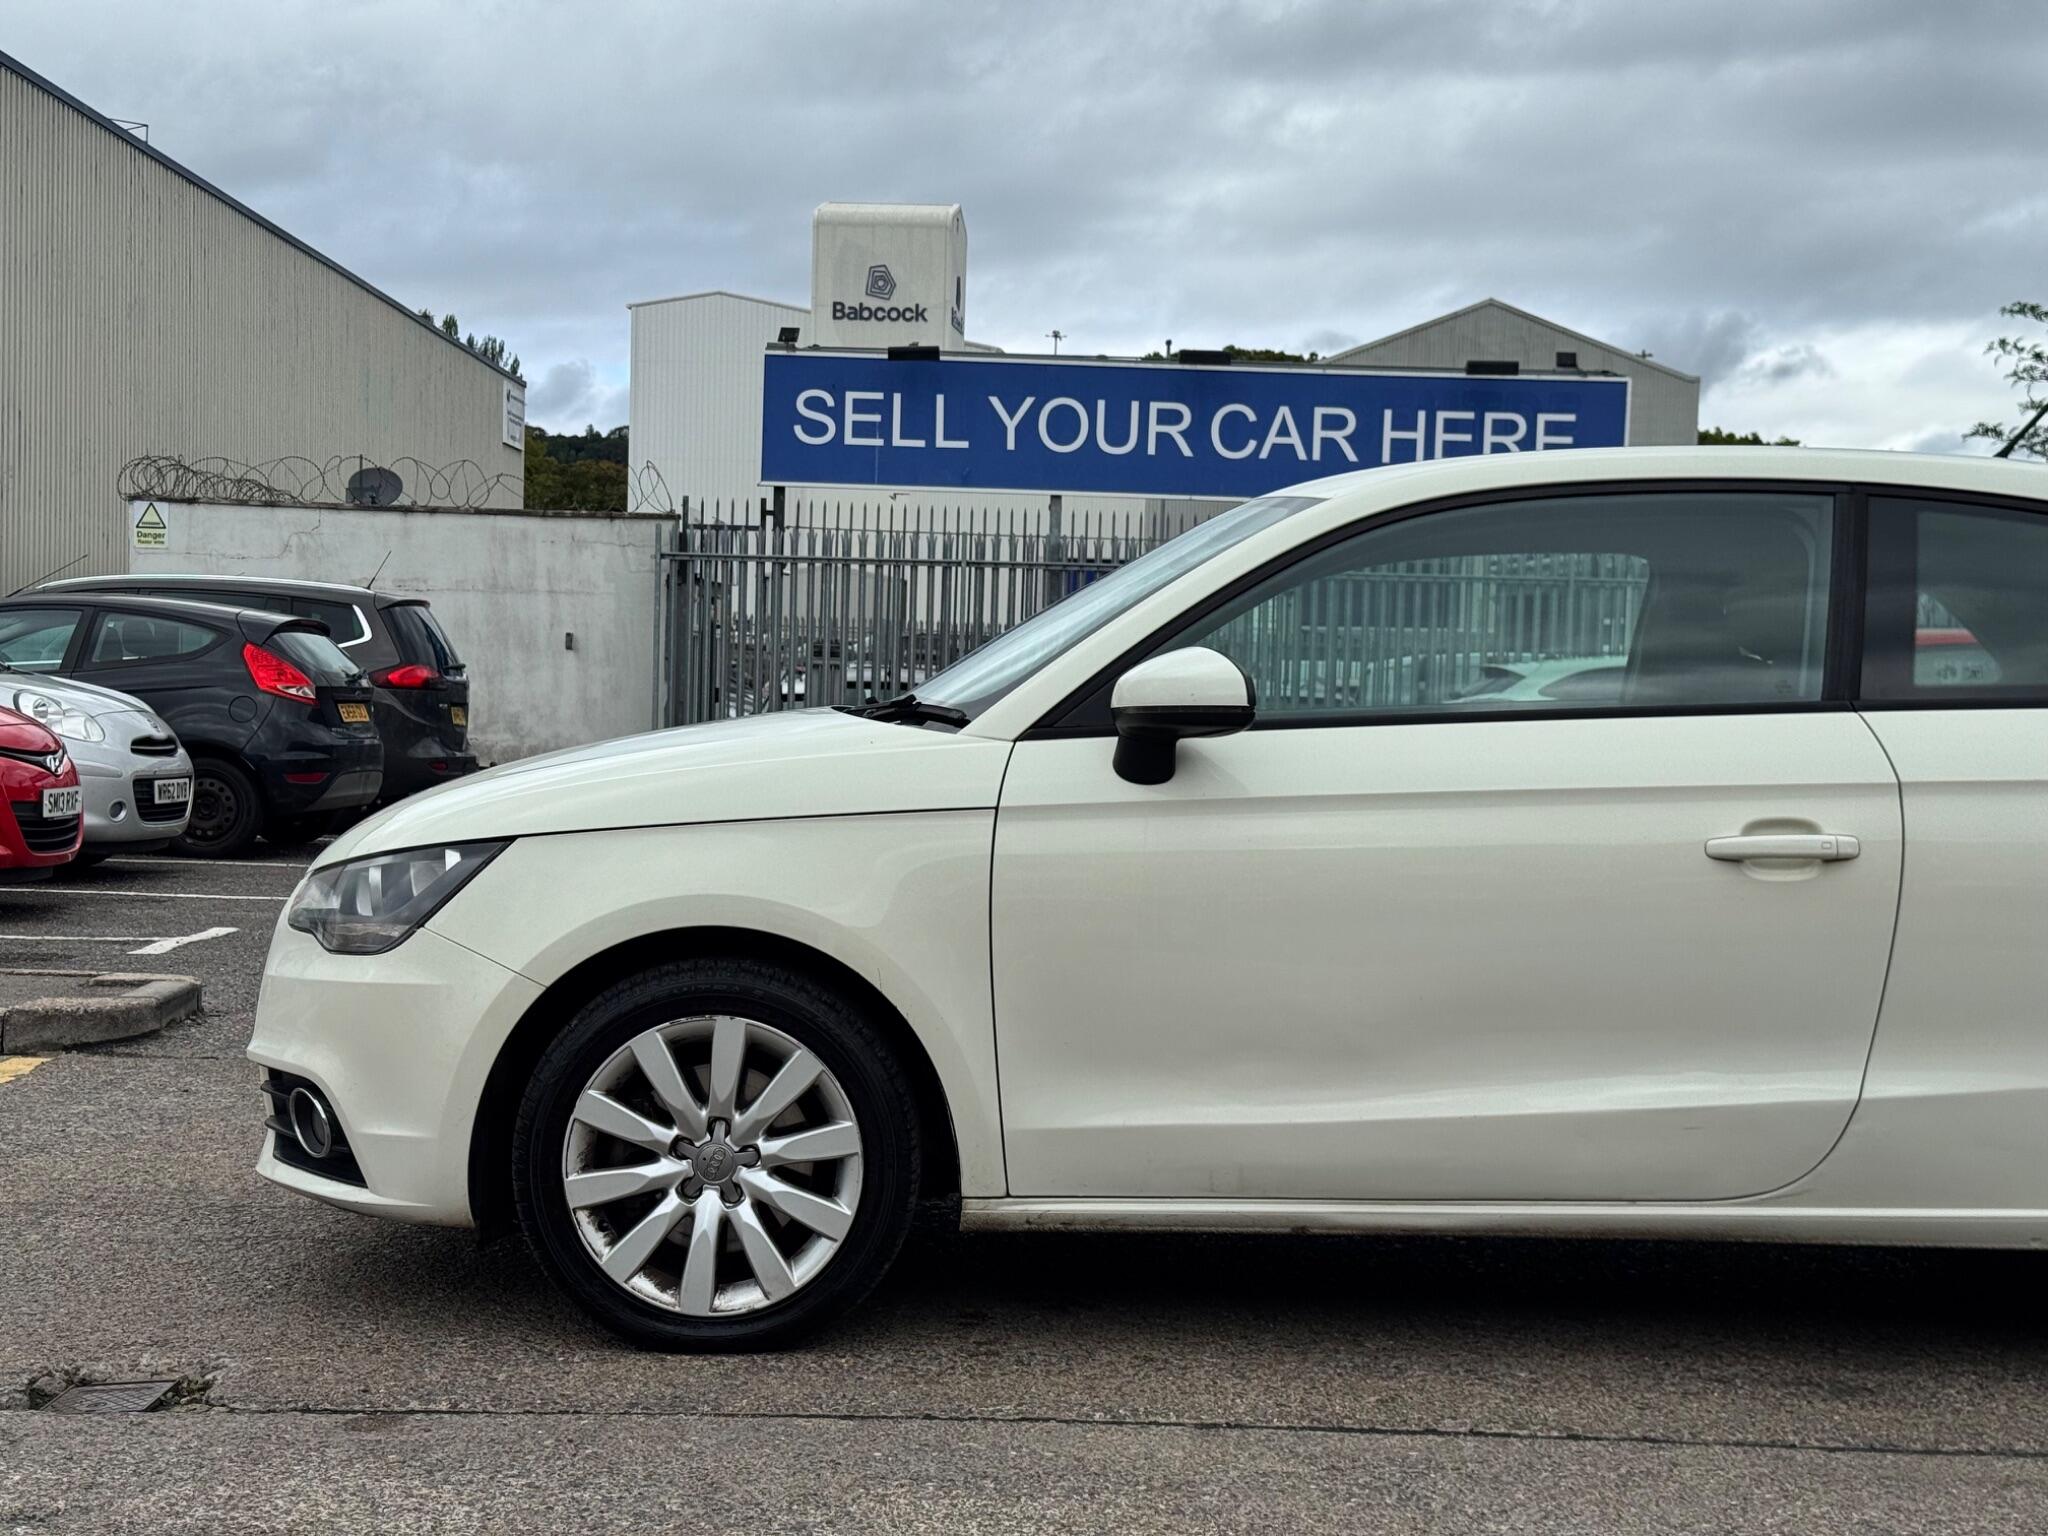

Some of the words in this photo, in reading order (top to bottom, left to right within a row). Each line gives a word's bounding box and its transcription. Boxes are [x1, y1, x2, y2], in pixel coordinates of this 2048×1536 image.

[832, 301, 928, 322] Babcock
[793, 389, 969, 449] SELL
[988, 395, 1194, 458] YOUR
[1210, 403, 1359, 463] CAR
[1381, 408, 1577, 463] HERE
[136, 531, 165, 540] Danger
